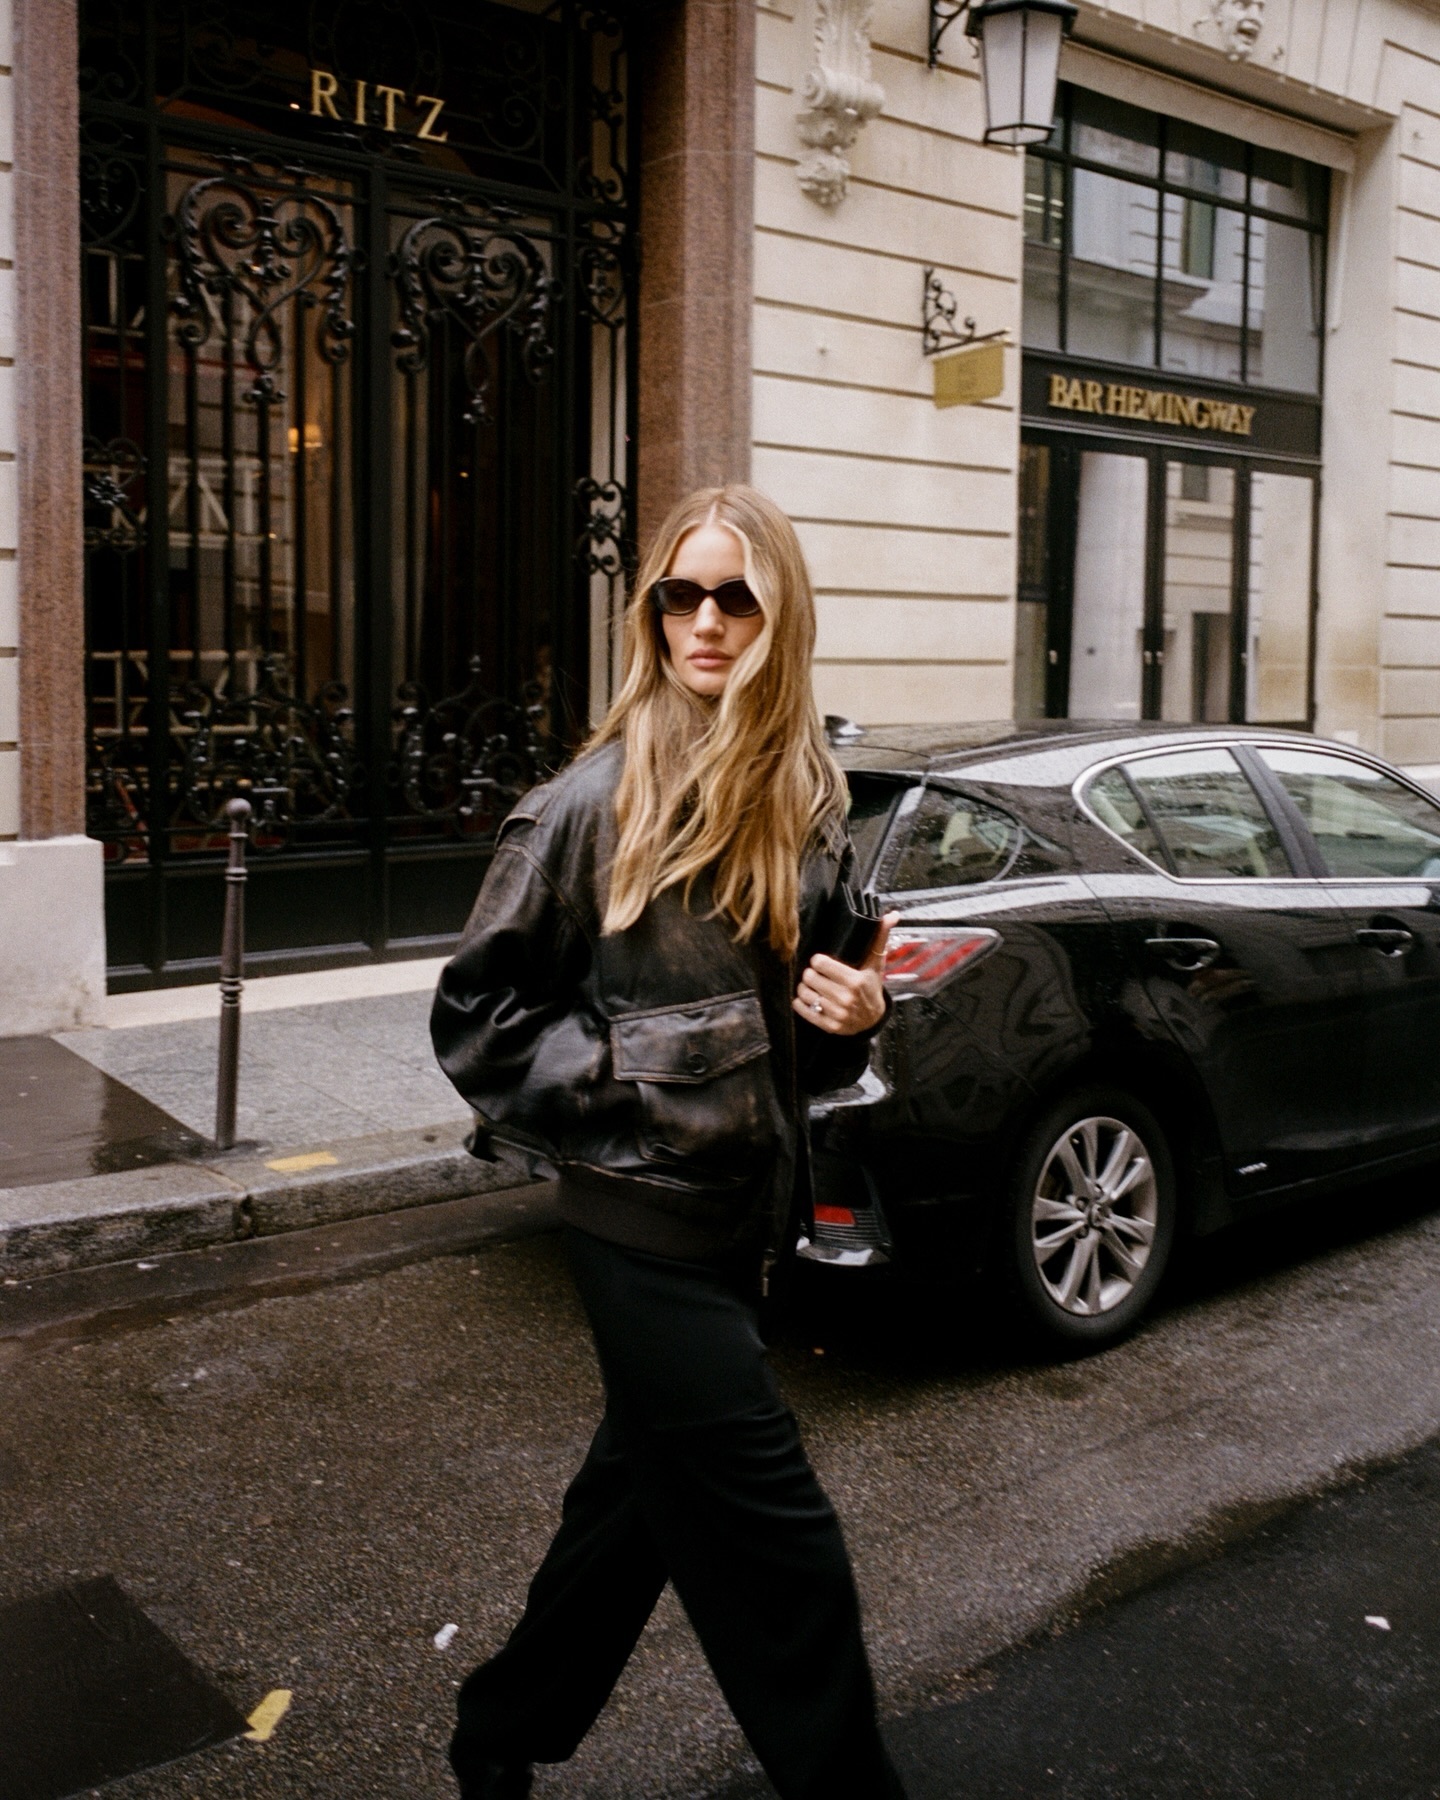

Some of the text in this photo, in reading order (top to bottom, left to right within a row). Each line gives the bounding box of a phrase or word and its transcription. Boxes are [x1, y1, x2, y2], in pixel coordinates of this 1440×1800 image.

[311, 70, 447, 142] RITZ
[1049, 374, 1256, 435] BAR HEMINGWAY
